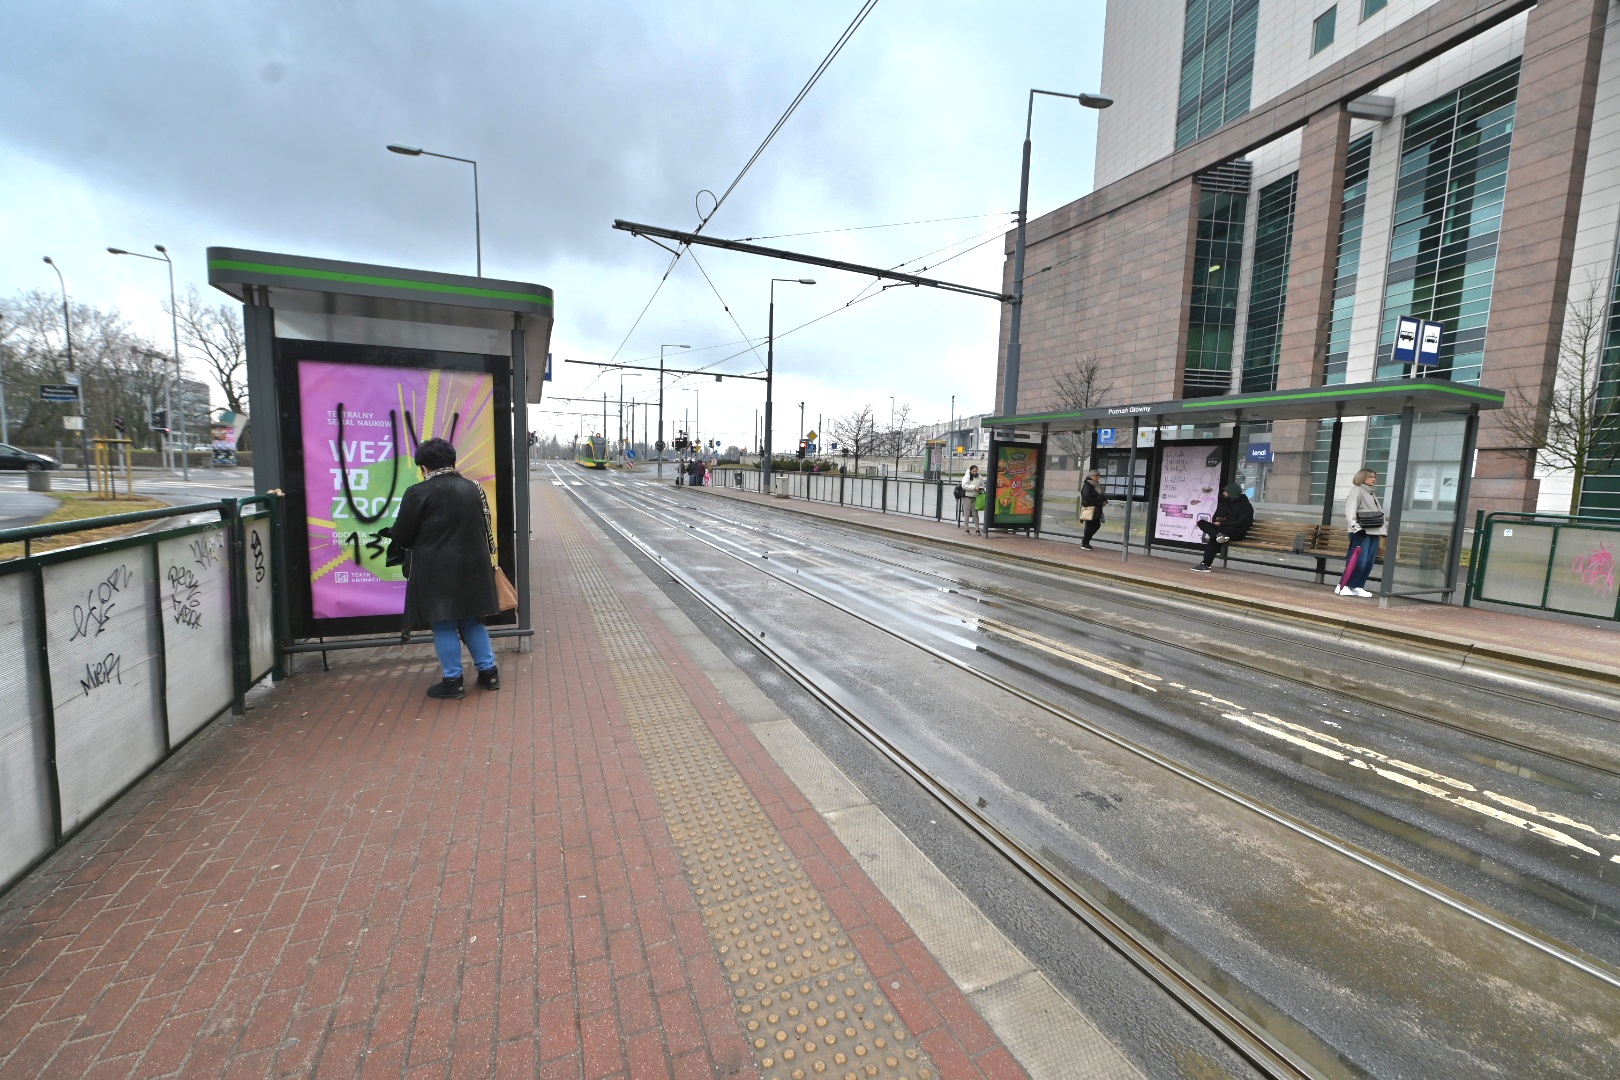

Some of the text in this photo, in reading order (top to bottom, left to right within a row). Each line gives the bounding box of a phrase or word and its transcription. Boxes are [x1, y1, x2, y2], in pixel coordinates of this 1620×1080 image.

[327, 410, 374, 419] TETRALNY
[357, 419, 396, 427] NAUKOW
[328, 434, 394, 463] WEŹ
[329, 468, 369, 491] TO
